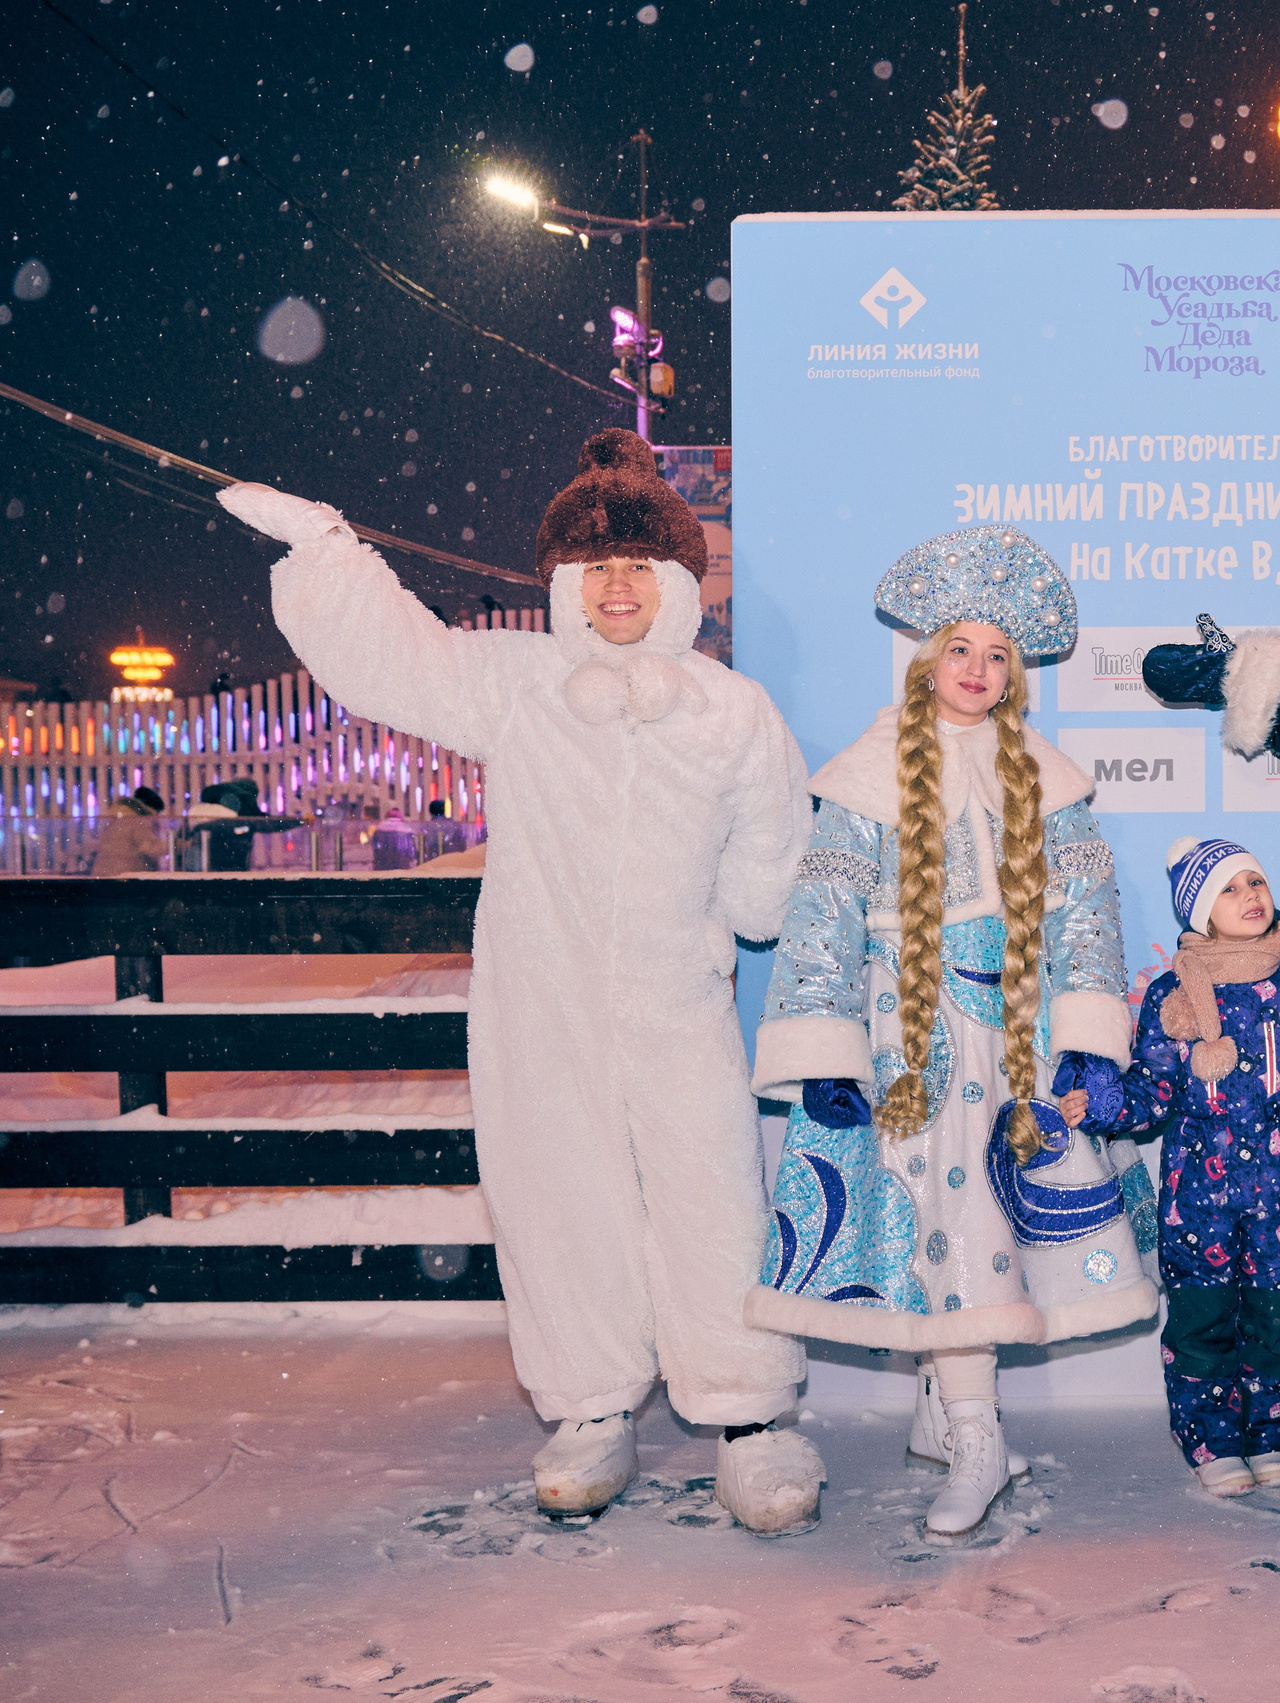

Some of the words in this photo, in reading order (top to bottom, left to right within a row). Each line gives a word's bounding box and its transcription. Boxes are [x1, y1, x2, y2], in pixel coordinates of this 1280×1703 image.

[1150, 292, 1279, 327] Усадьба
[1176, 321, 1253, 351] Деда
[807, 343, 887, 361] ЛИНИЯ
[894, 342, 980, 360] ЖИЗНИ
[1143, 345, 1266, 380] Мороза
[807, 366, 941, 381] благотворительный
[945, 366, 980, 380] фонд
[953, 468, 1104, 524] ЗИМНИЙ
[1114, 682, 1143, 691] МОСКВА
[1094, 757, 1174, 783] мел
